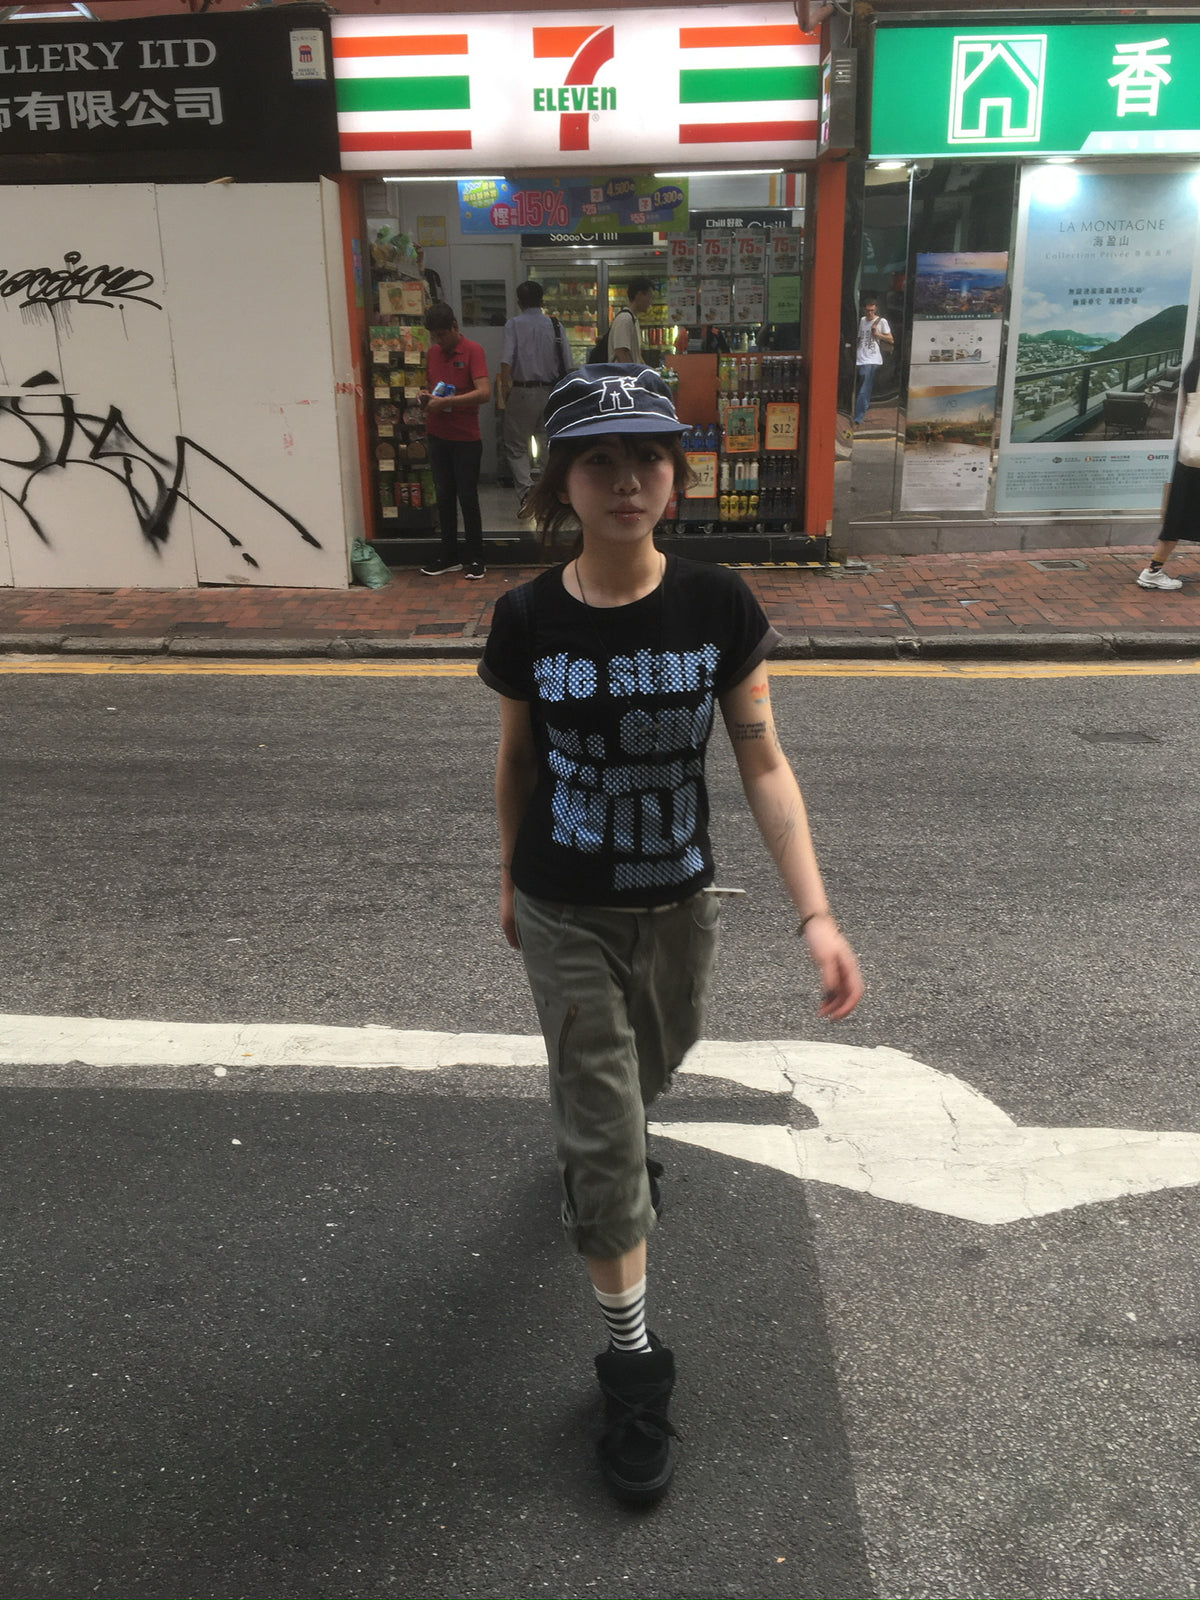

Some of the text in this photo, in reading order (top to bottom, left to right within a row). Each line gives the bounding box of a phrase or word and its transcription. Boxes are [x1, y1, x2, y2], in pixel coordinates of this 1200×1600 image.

[0, 38, 217, 74] LLERY LTD
[1107, 38, 1173, 118] 香
[512, 190, 569, 227] 15%
[1060, 219, 1166, 232] LA MONTAGNE
